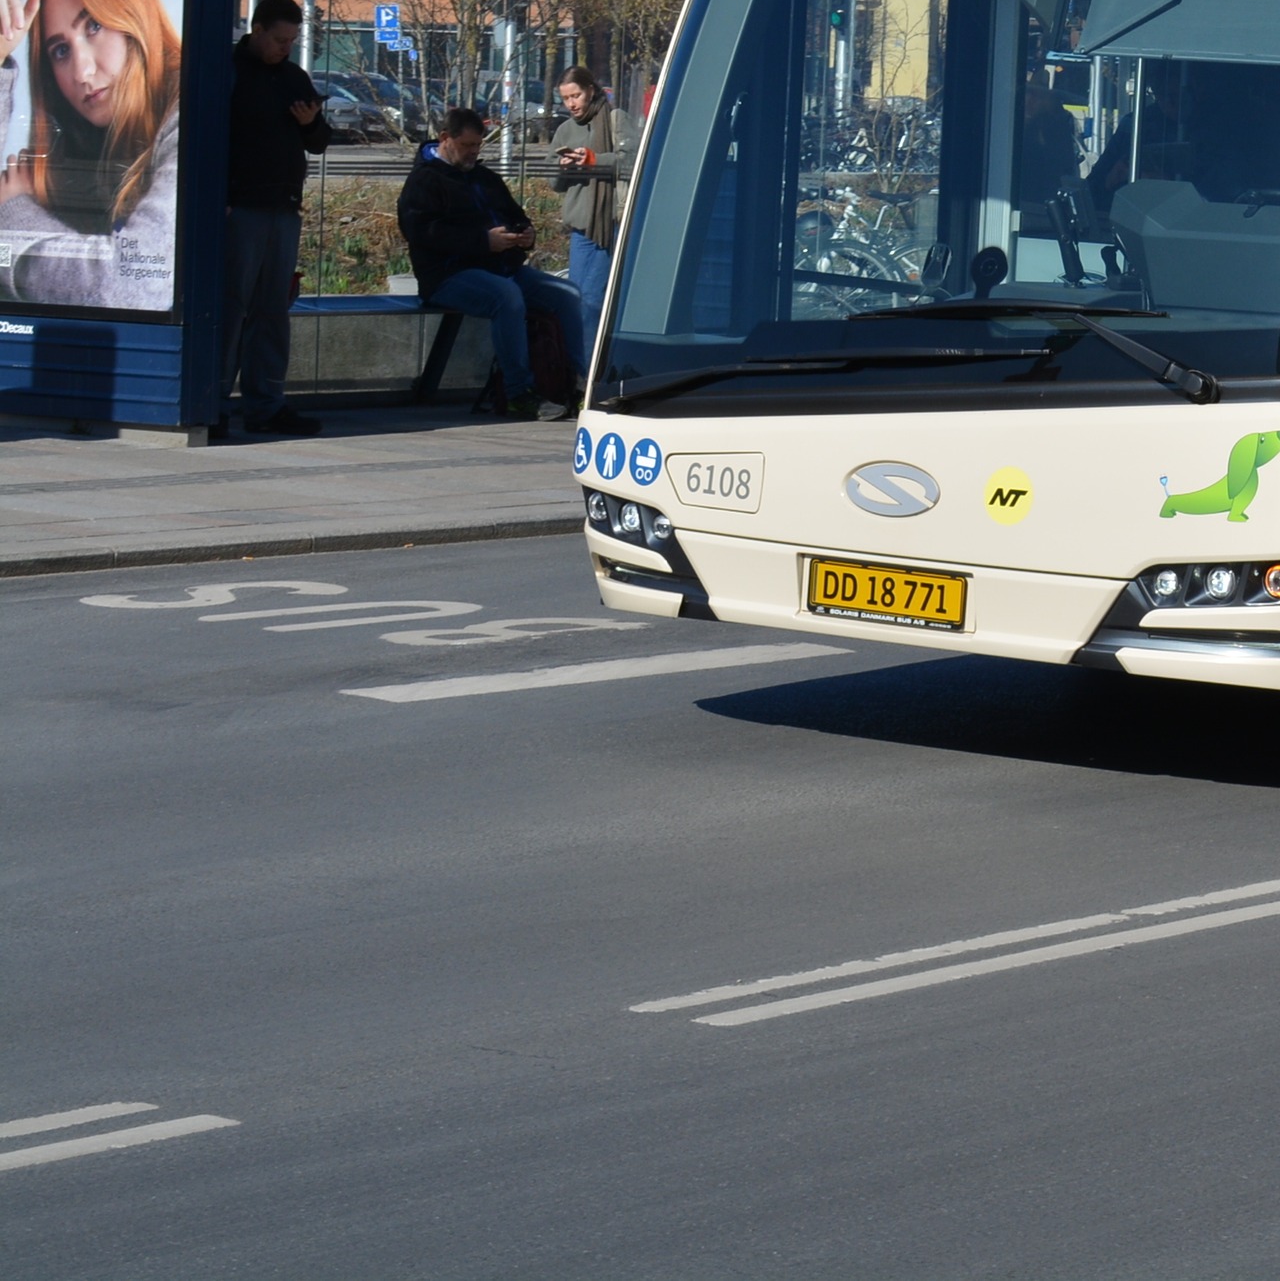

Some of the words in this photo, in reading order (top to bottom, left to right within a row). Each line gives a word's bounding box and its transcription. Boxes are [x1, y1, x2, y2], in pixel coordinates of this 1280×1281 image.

[121, 237, 139, 249] Det
[120, 253, 166, 265] Nationale
[119, 265, 171, 280] Sorgcenter
[686, 462, 752, 501] 6108
[988, 487, 1028, 508] NT
[823, 570, 858, 602] DD
[866, 576, 896, 608] 18
[903, 580, 947, 615] 771
[829, 608, 859, 618] SOLARIS
[860, 612, 896, 623] DANMARK
[896, 616, 912, 624] BUS
